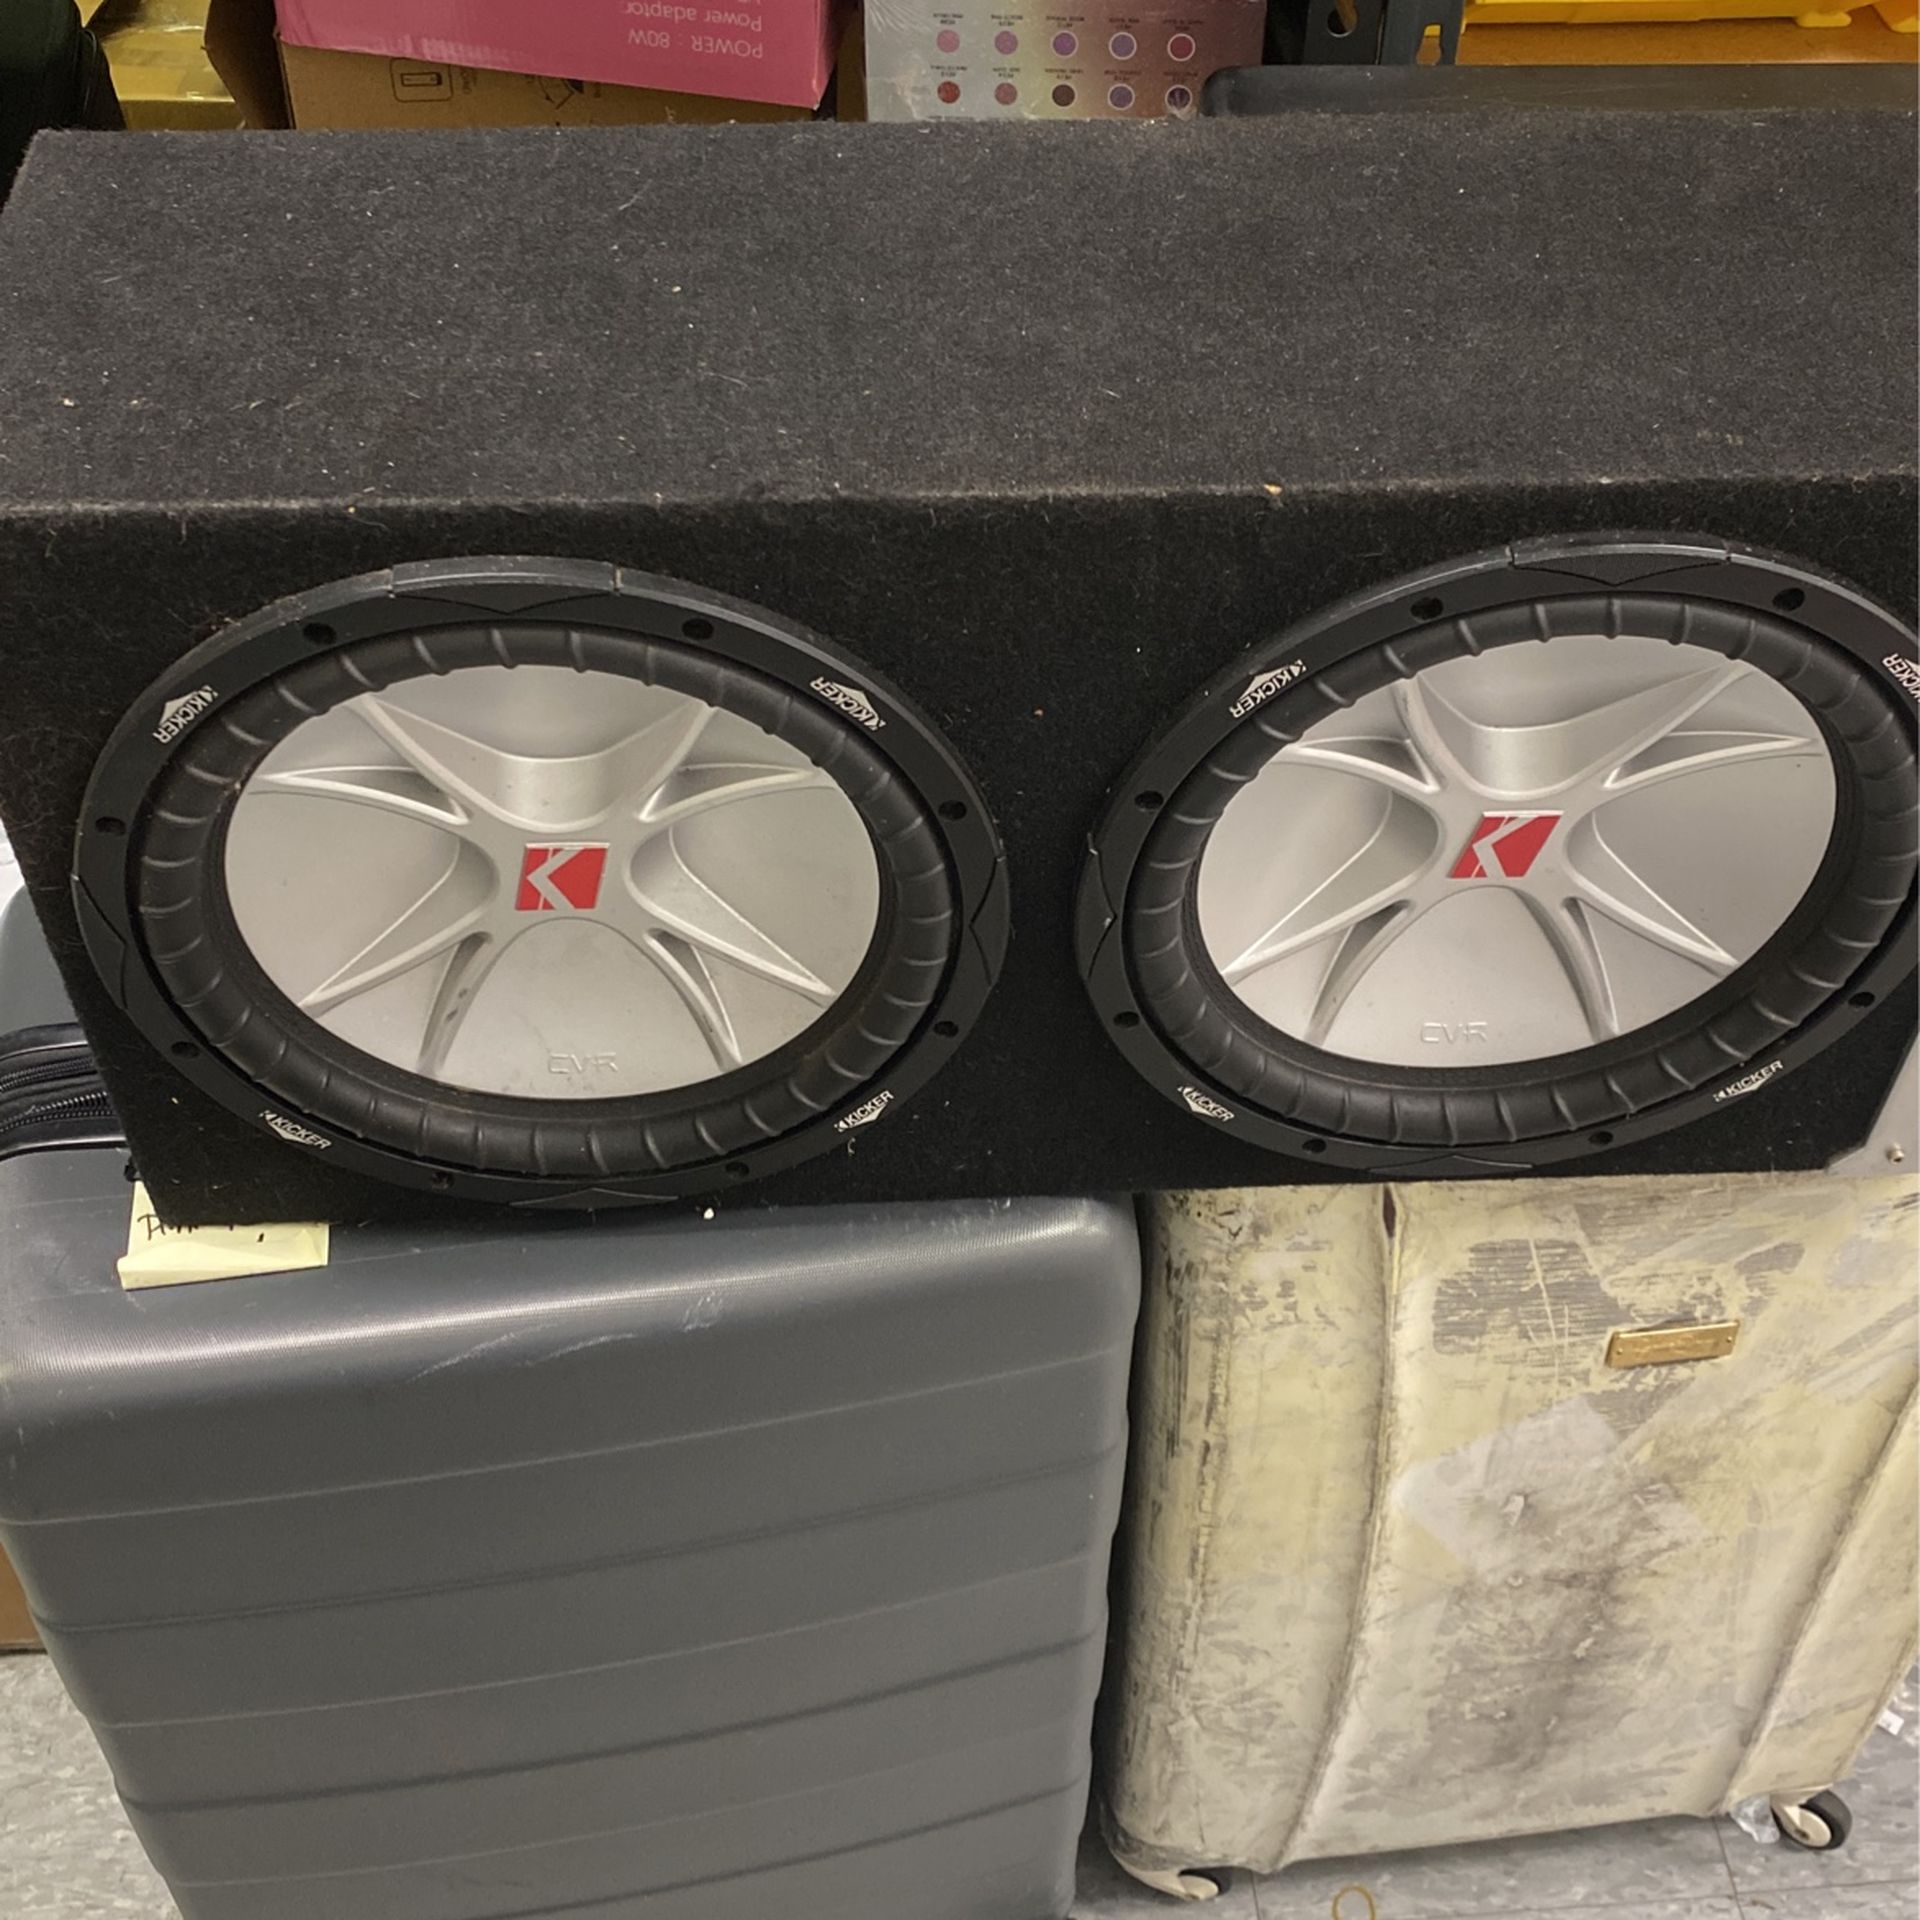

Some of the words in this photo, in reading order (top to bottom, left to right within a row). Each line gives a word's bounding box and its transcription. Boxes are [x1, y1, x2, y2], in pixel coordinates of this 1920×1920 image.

[625, 2, 697, 24] adaptor
[704, 10, 762, 32] Power
[628, 28, 671, 48] 80W
[691, 35, 764, 59] POWER
[809, 676, 874, 722] KICKER
[1228, 669, 1293, 718] KICKER
[152, 692, 208, 744] KICKER
[1420, 1020, 1489, 1045] CVR
[546, 1050, 619, 1075] CVR
[1725, 1058, 1784, 1097] KICKER
[844, 1089, 895, 1127] KICKER
[1184, 1091, 1236, 1123] KICKER
[270, 1116, 332, 1150] KICKER
